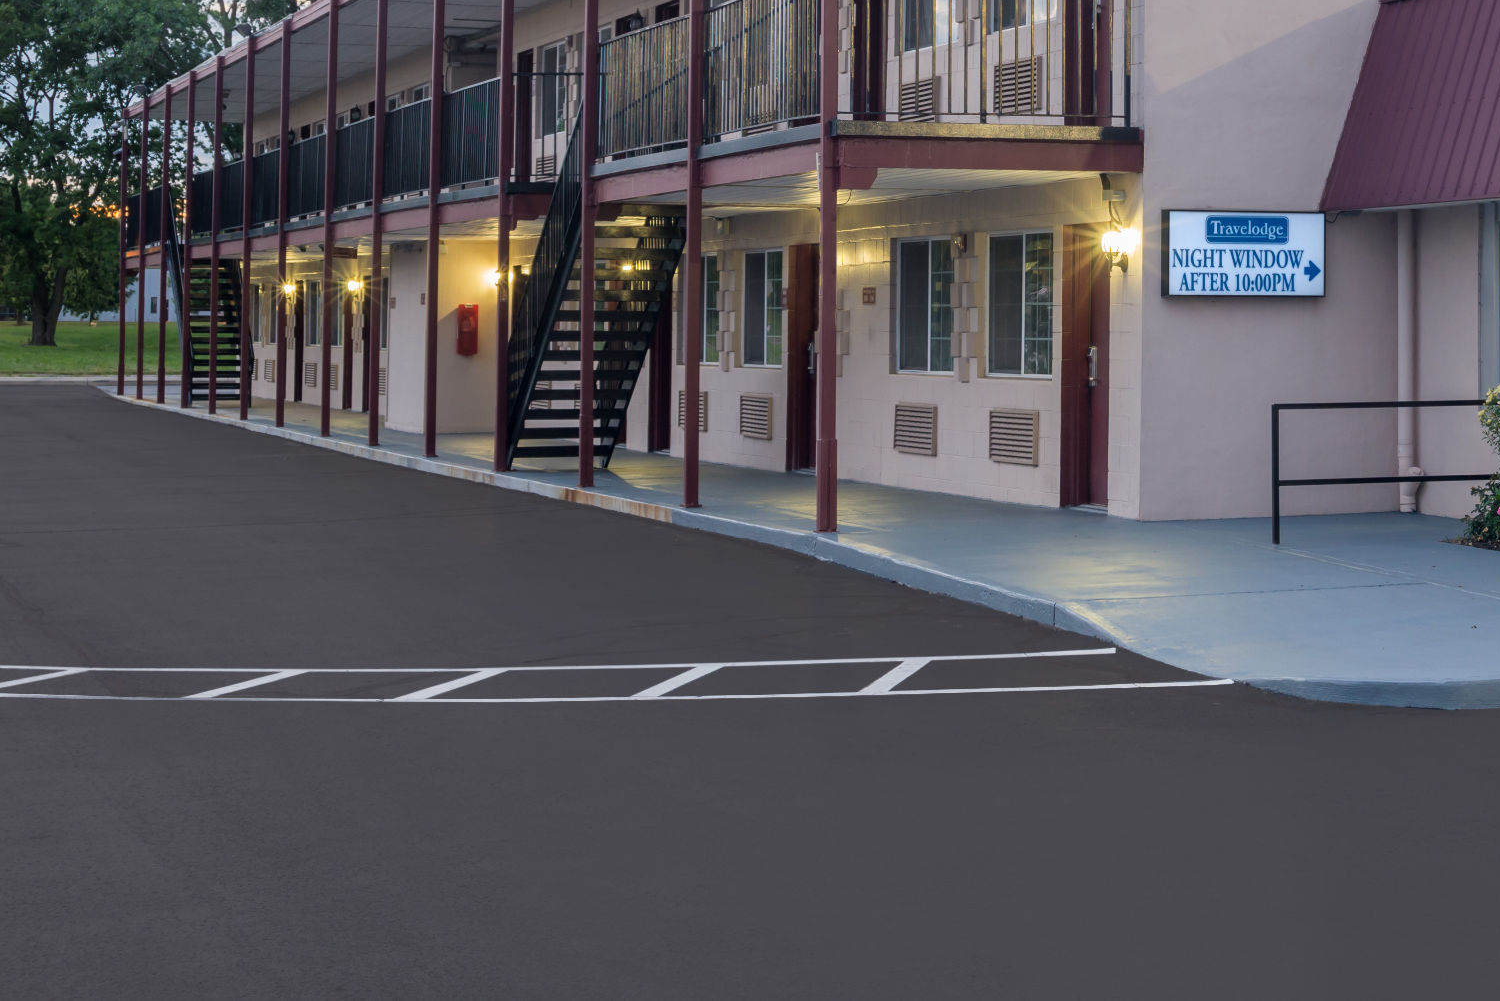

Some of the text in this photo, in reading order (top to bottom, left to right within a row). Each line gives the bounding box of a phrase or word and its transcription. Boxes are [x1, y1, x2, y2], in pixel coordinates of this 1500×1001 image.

[1210, 220, 1284, 239] Travelodge
[1172, 248, 1305, 269] NIGHT WINDOW
[1179, 273, 1296, 292] AFTER 10:00PM
